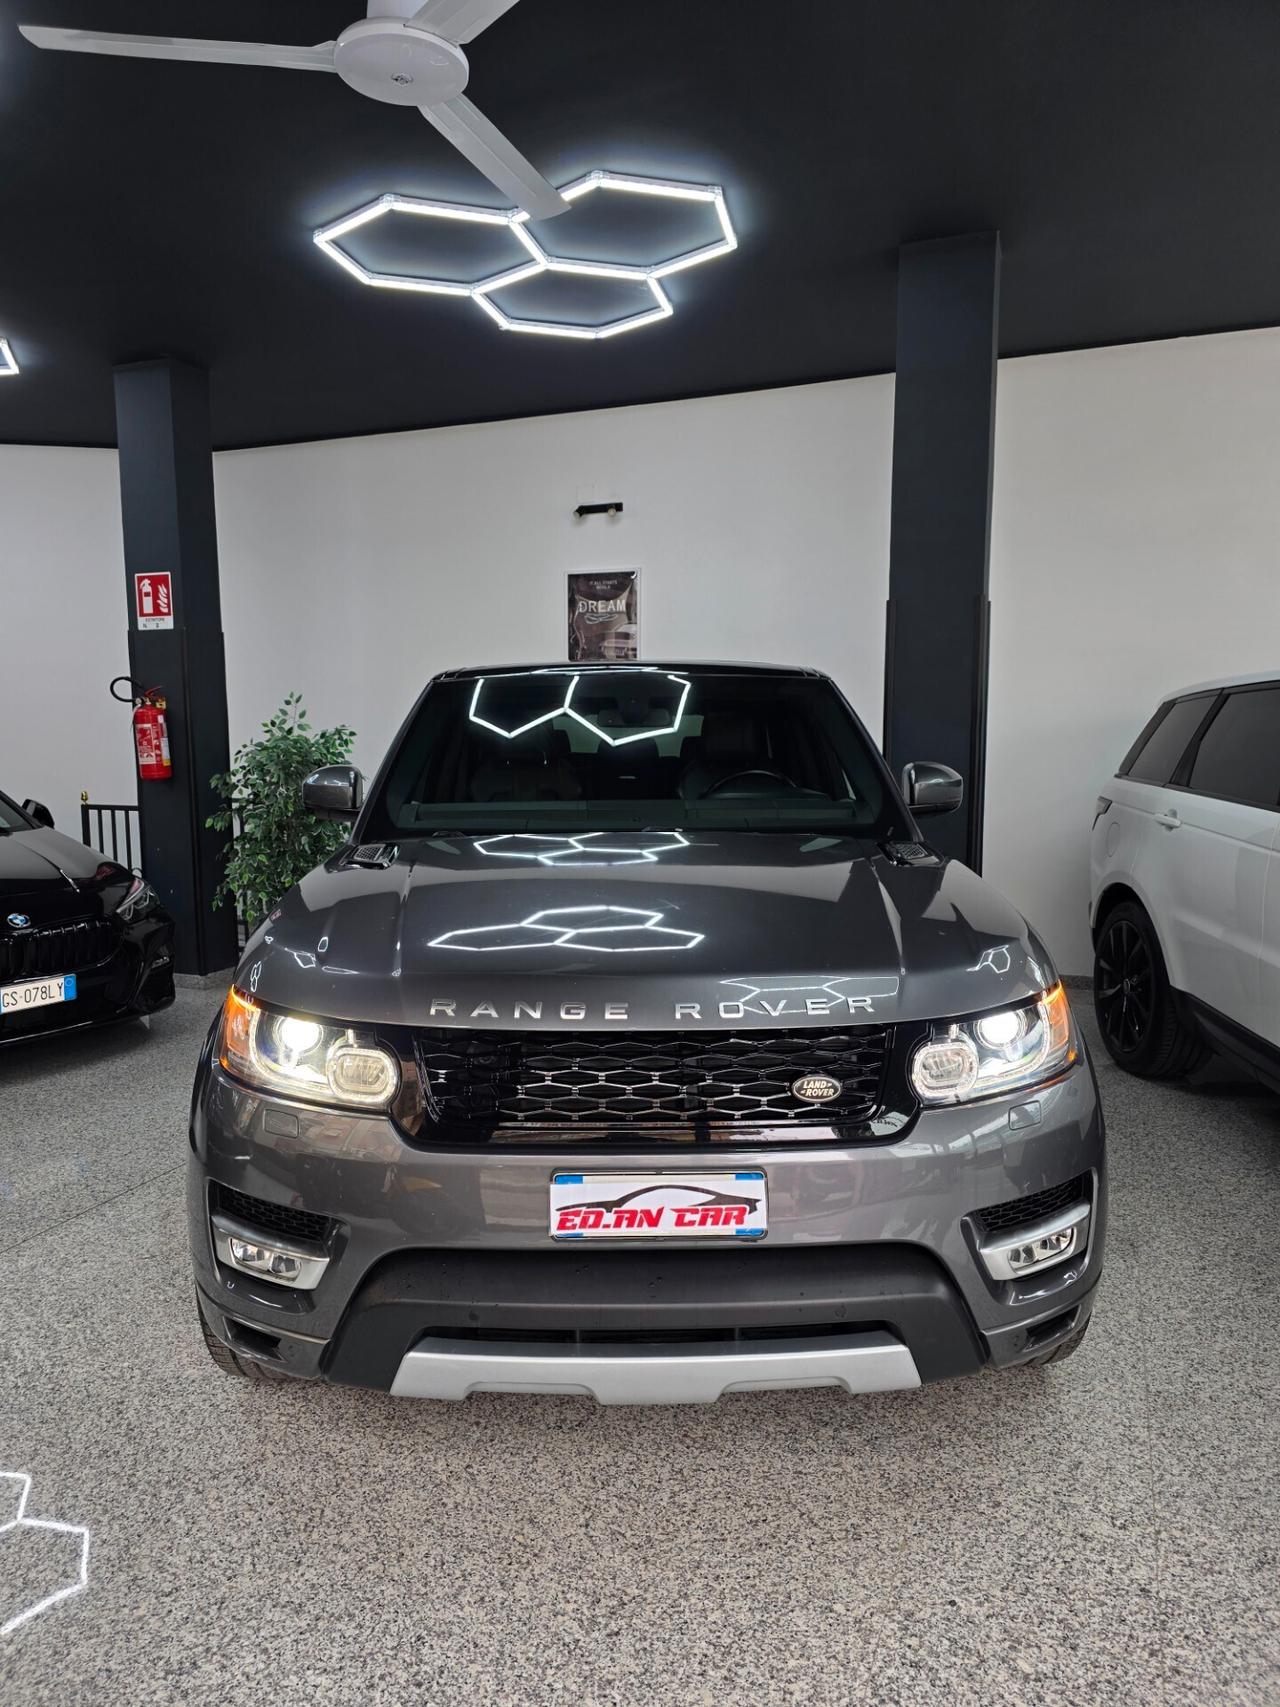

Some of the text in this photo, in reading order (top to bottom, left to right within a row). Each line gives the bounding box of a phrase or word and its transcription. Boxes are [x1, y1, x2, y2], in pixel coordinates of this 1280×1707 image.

[579, 600, 626, 612] DREAM
[430, 997, 874, 1020] RANGE ROVER
[803, 1080, 827, 1089] LAND
[805, 1088, 834, 1097] ROVER
[556, 1206, 748, 1231] ED.AN CAR
